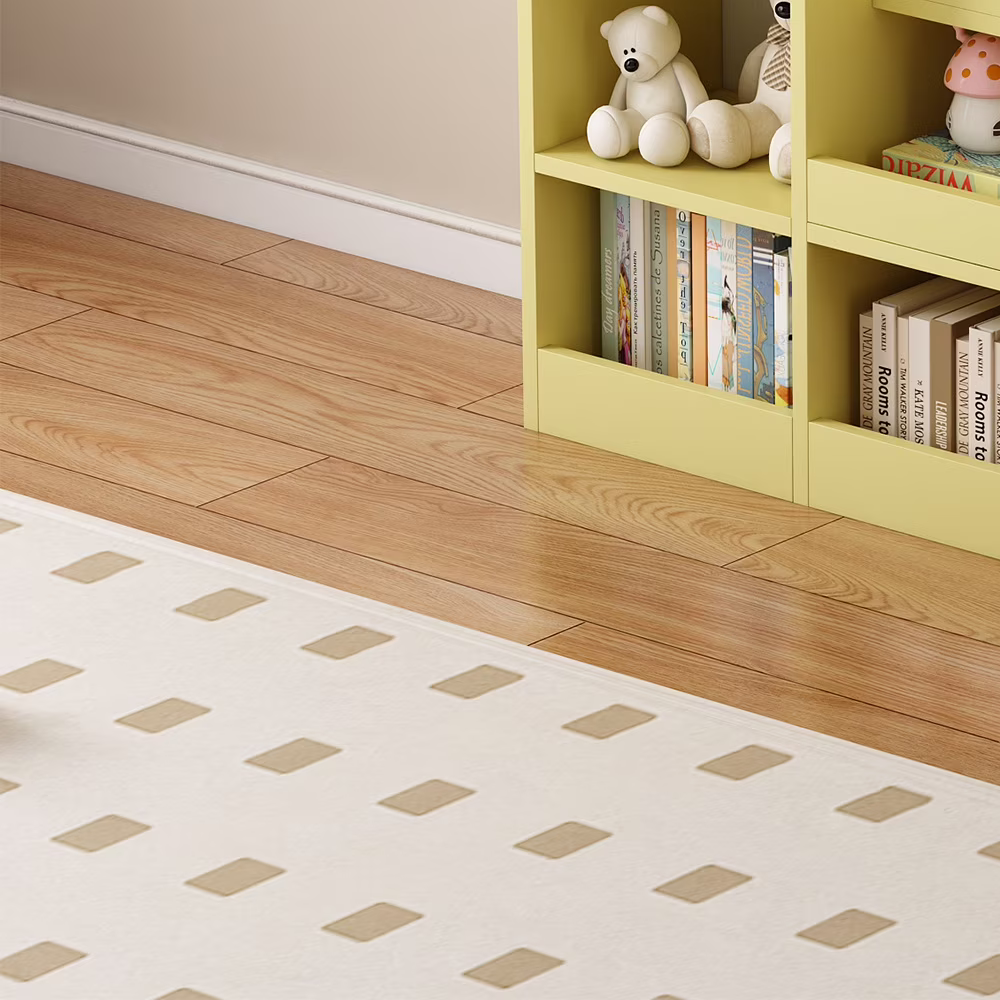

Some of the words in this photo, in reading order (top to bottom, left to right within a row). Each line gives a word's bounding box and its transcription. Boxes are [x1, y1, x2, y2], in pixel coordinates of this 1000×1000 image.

[651, 209, 663, 265] Susana
[601, 247, 613, 305] dreamers
[651, 268, 661, 285] de
[602, 307, 618, 334] Day
[652, 289, 663, 356] calcetines
[862, 327, 873, 382] MOUNTAIN
[862, 382, 873, 411] GRAY
[878, 366, 891, 416] Rooms
[914, 389, 924, 417] KATE
[958, 352, 969, 409] MOUNTAIN
[879, 419, 891, 435] to
[935, 401, 947, 449] LEADERSHIP
[958, 409, 969, 437] GRAY
[975, 391, 988, 441] Rooms
[975, 444, 988, 461] to
